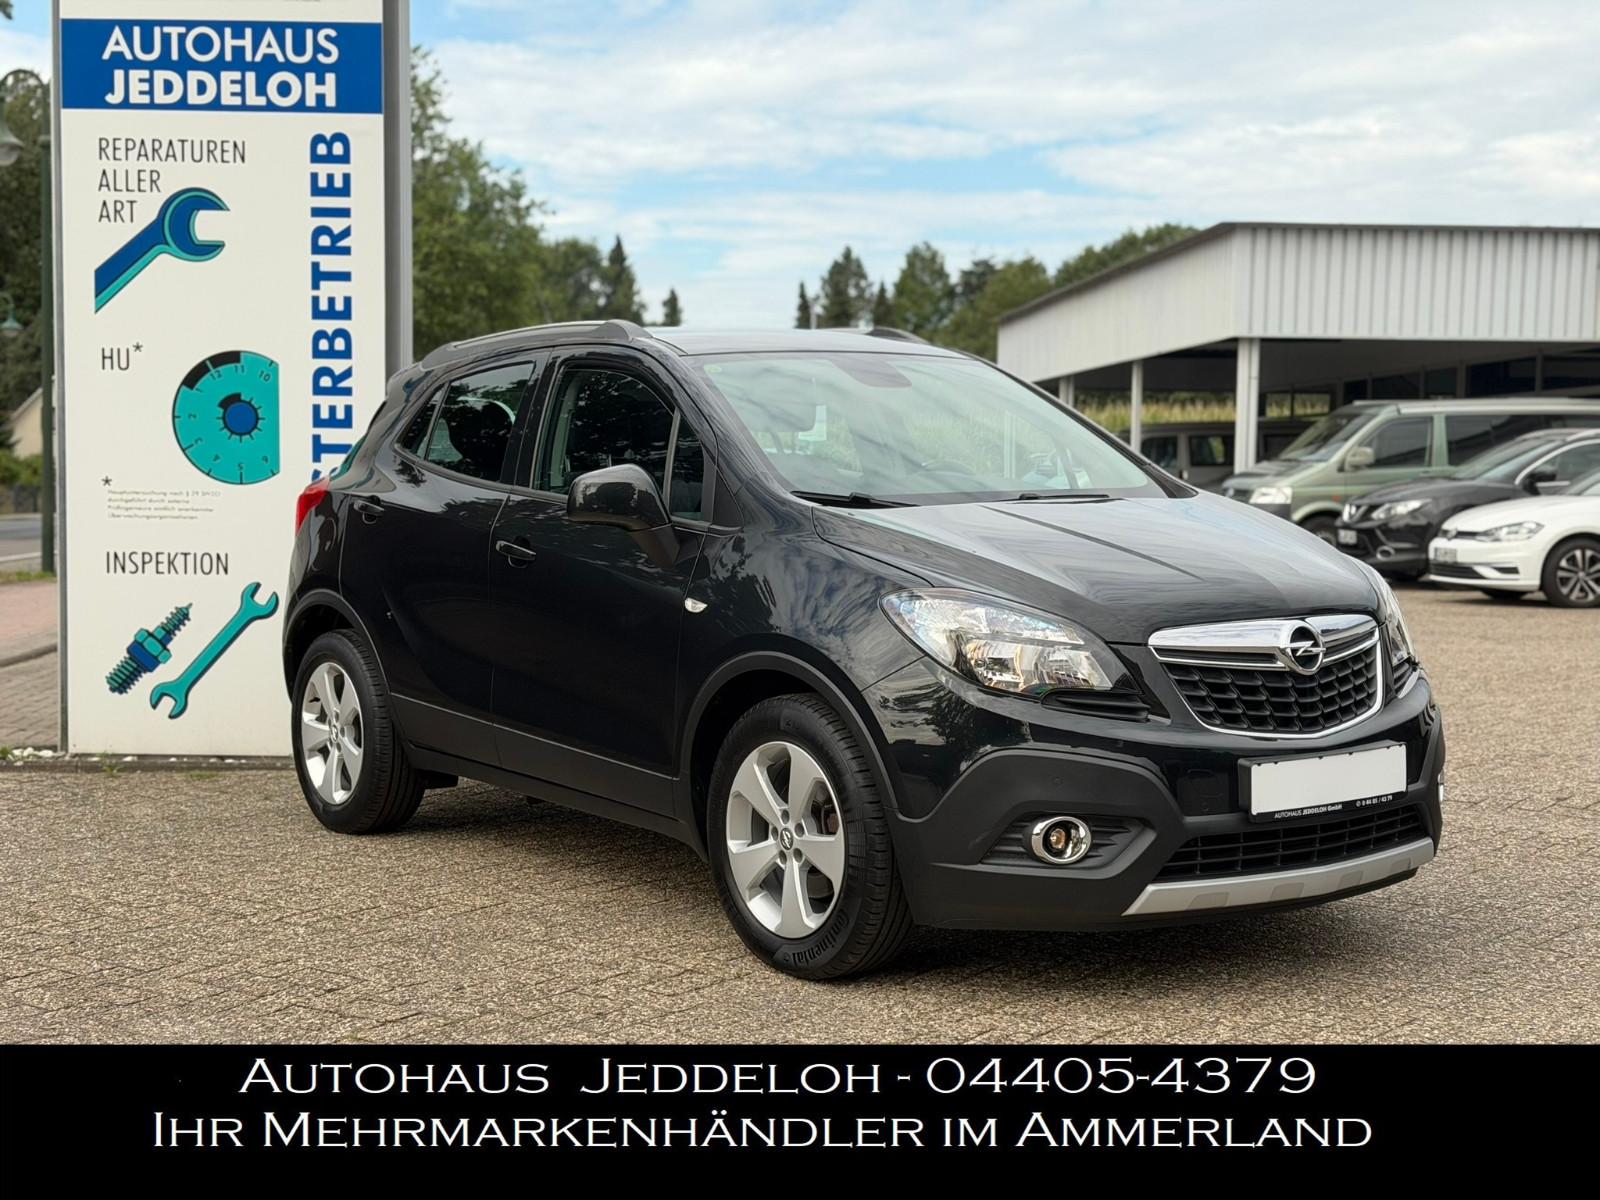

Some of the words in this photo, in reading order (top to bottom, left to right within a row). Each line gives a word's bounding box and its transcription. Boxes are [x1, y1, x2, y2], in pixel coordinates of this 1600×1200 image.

[102, 25, 339, 64] AUTOHAUS
[104, 69, 336, 107] JEDDELOH
[98, 137, 246, 164] REPARATUREN
[98, 169, 161, 193] ALLER
[98, 200, 137, 224] ART
[234, 364, 245, 374] 11
[258, 370, 271, 382] 10
[106, 551, 228, 575] INSPEKTION
[1274, 808, 1303, 819] AUTOHAUS
[1327, 803, 1343, 812] GmbH
